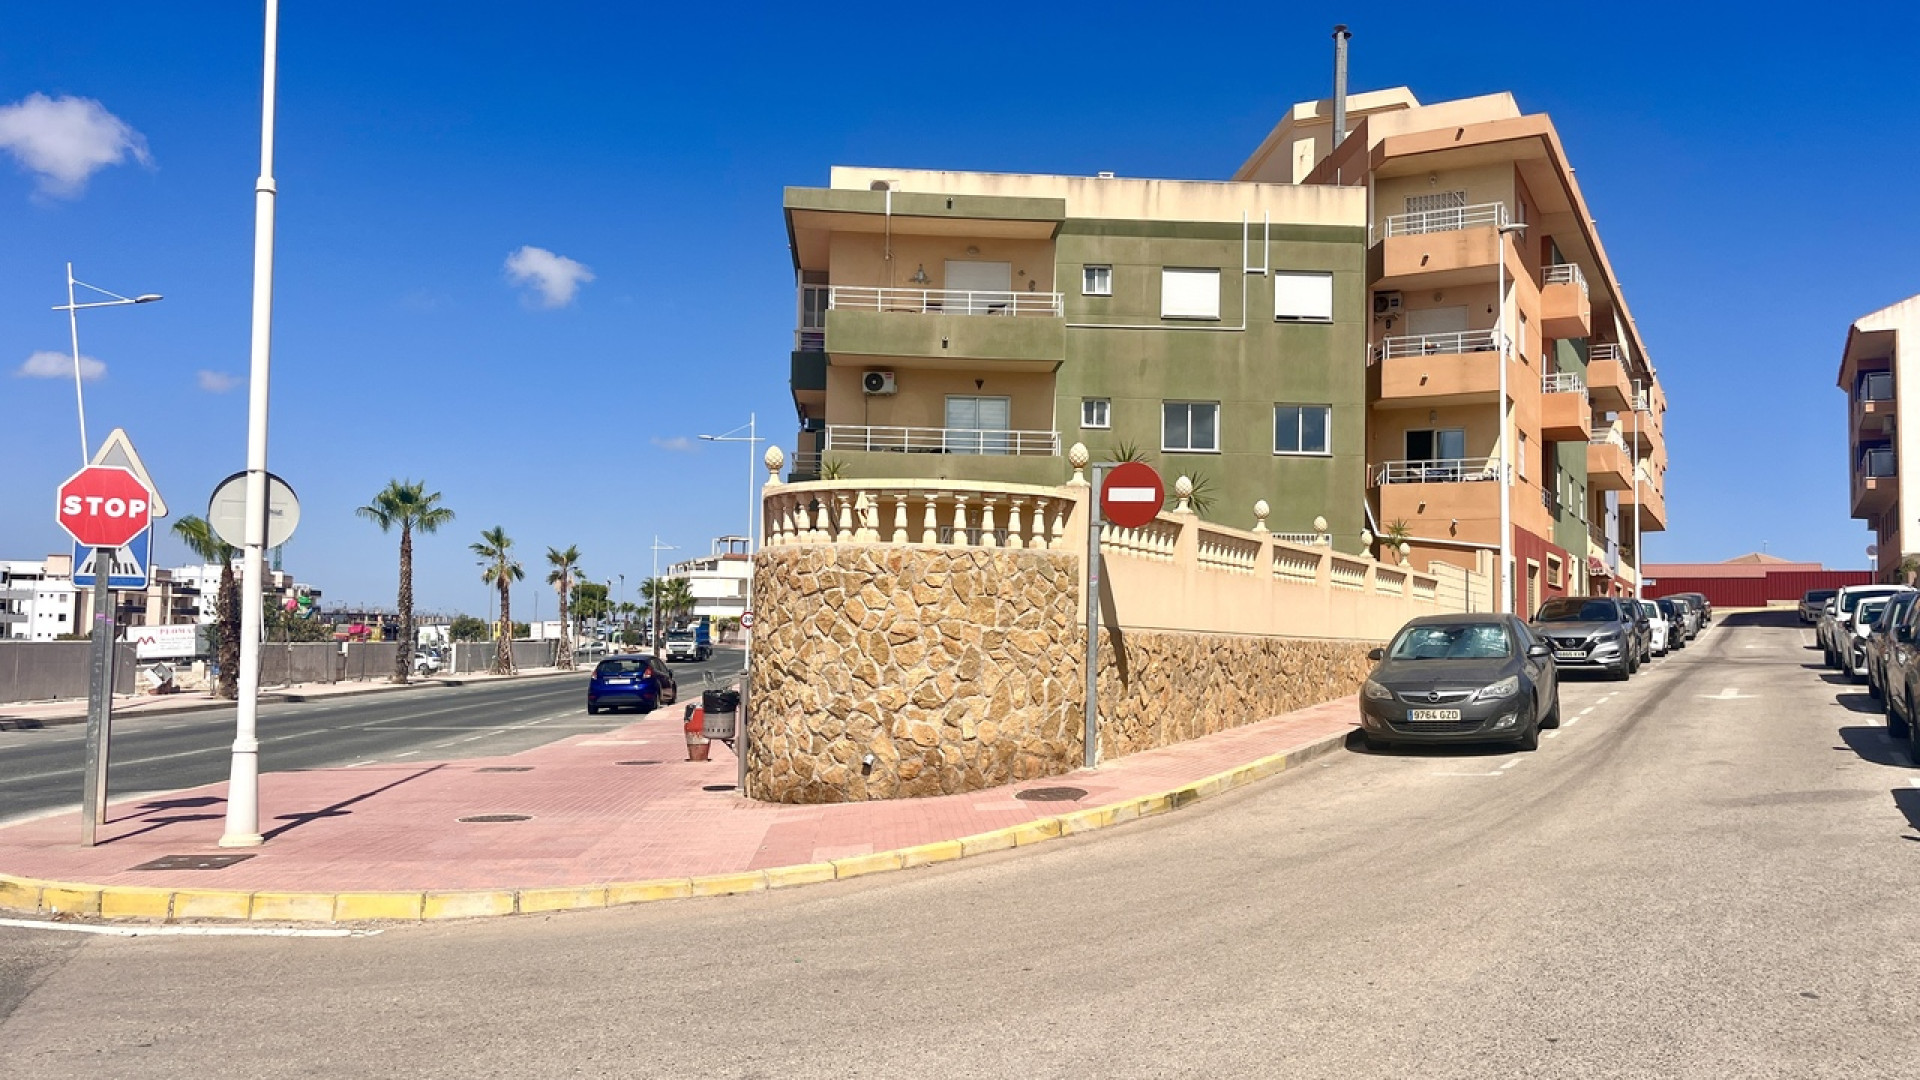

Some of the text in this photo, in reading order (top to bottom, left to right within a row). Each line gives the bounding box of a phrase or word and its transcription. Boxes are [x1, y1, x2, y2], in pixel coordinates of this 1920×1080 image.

[62, 495, 146, 519] STOP
[1414, 710, 1459, 720] 9764 GZD
